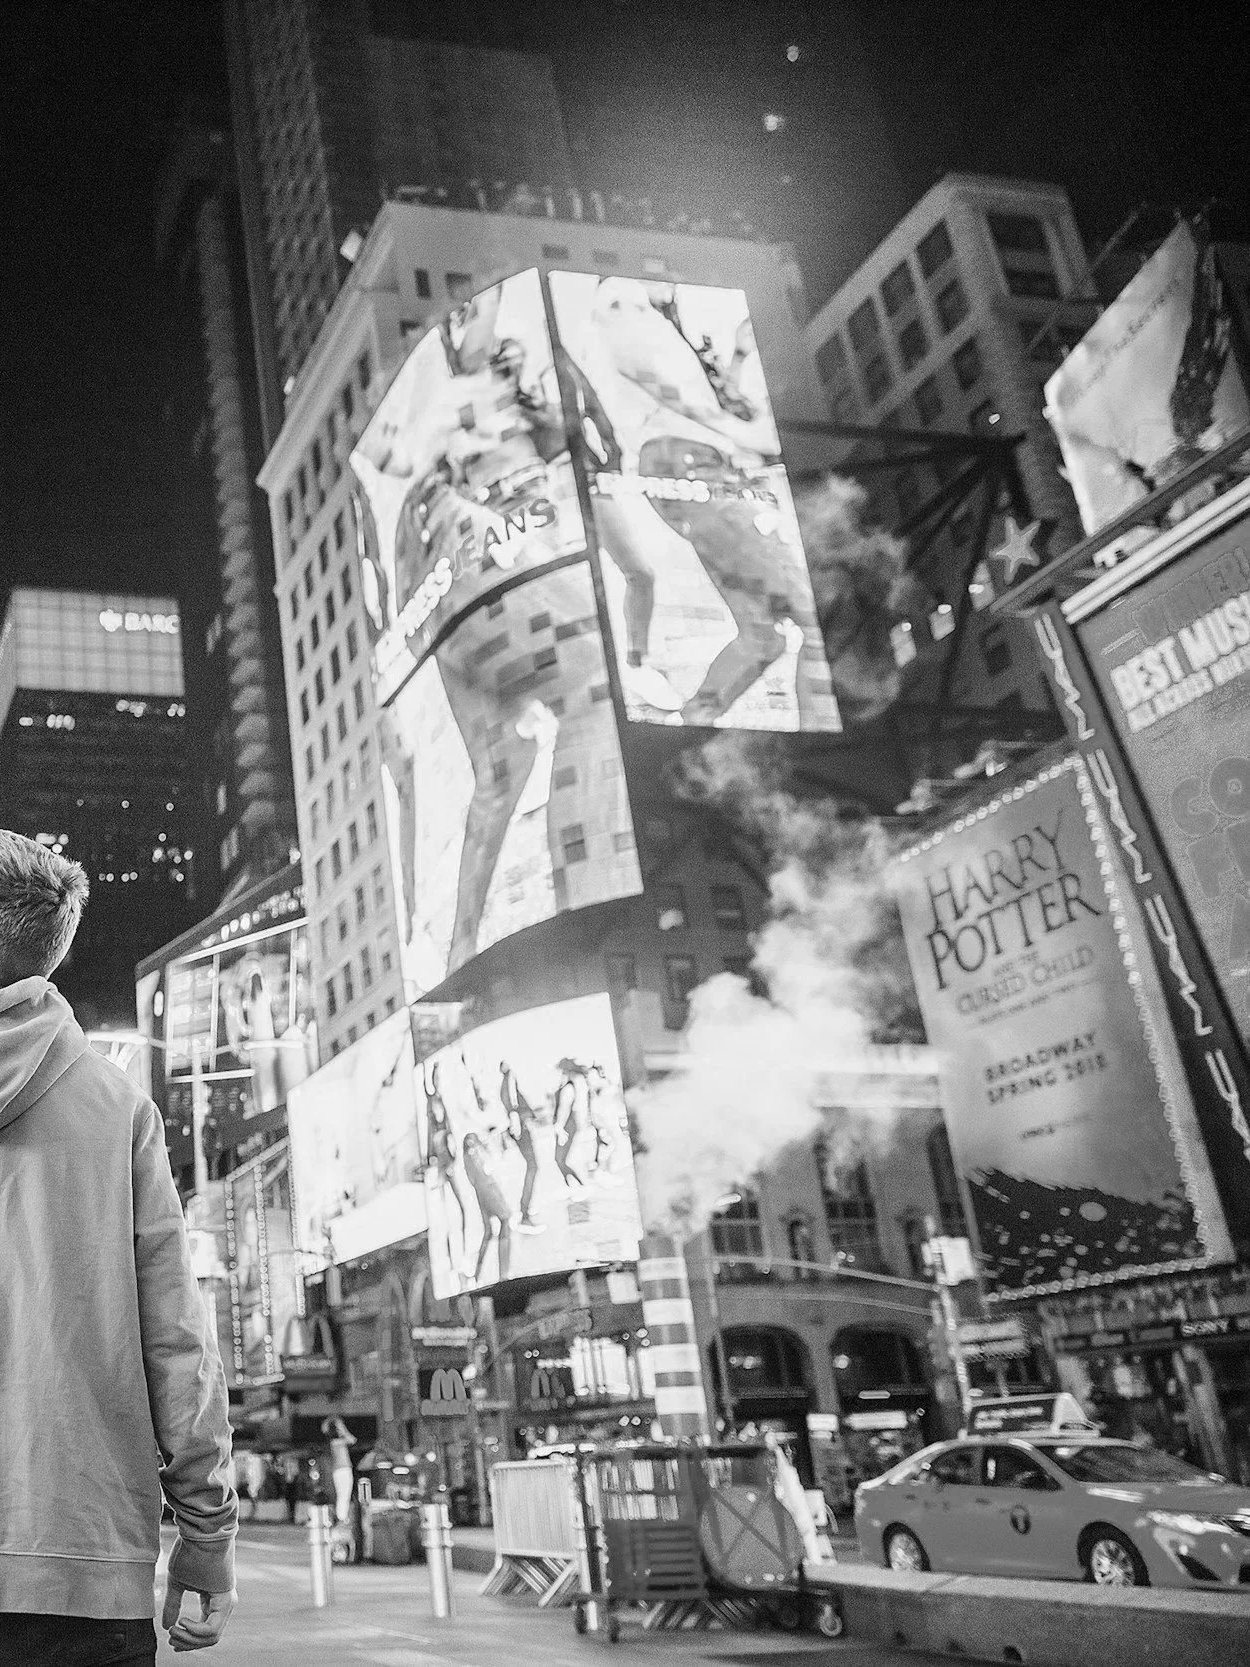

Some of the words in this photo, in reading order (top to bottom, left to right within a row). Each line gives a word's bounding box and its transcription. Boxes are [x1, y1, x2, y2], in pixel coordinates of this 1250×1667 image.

[1109, 634, 1186, 713] BEST
[925, 810, 1066, 930] HARRY
[927, 872, 1101, 990] POTTER
[983, 1030, 1097, 1084] BROADWAY
